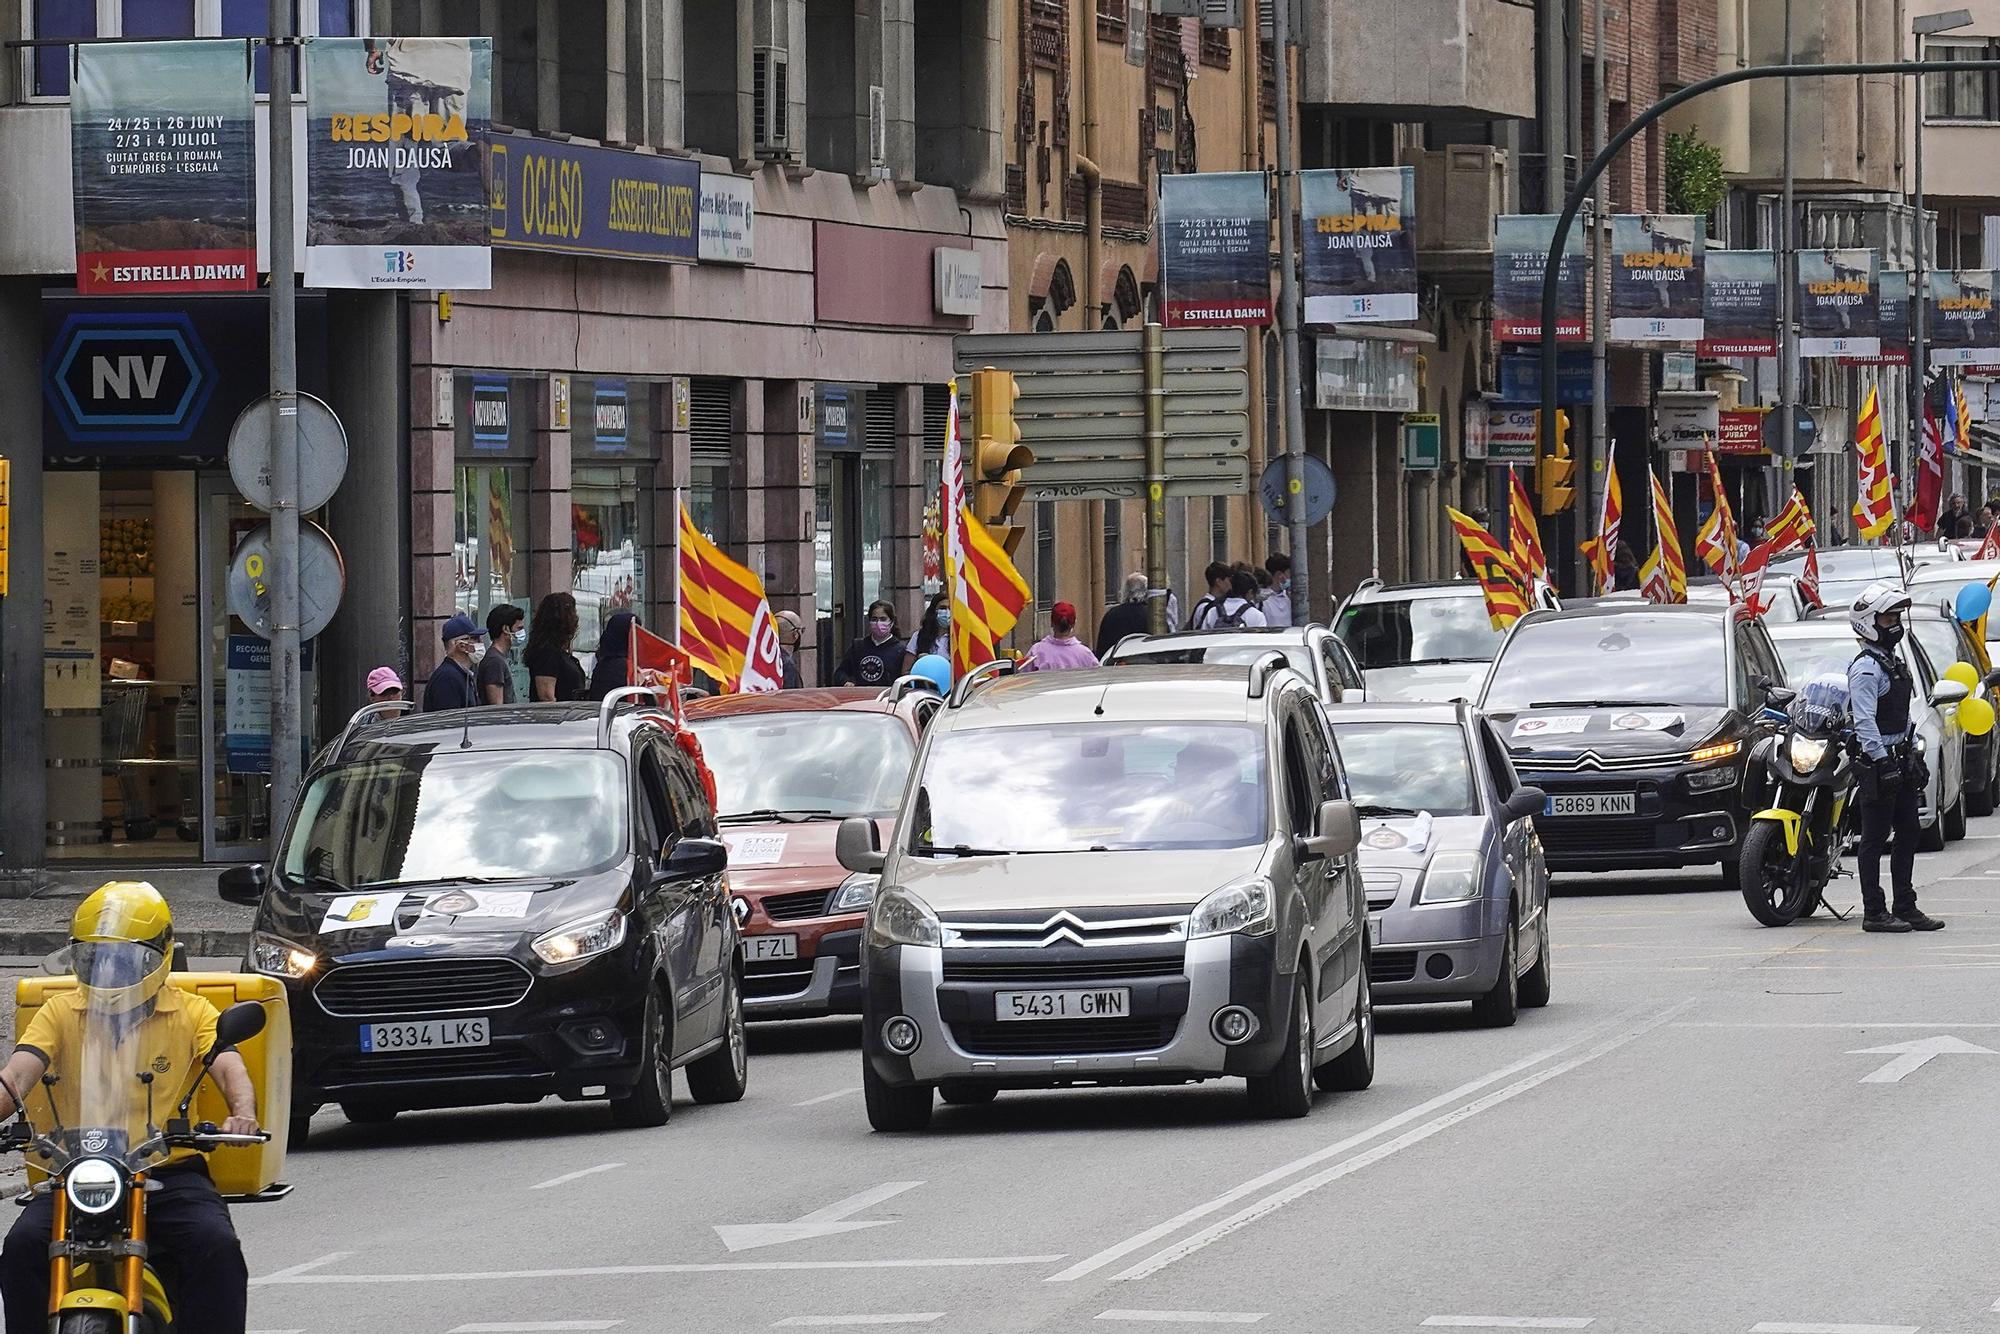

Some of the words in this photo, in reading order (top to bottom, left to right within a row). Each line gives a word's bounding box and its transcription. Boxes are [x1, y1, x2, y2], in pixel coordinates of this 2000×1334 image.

[107, 117, 150, 131] 24/25
[167, 116, 184, 129] 26
[190, 115, 223, 129] JUNY
[331, 113, 469, 143] RESPIRA
[116, 134, 140, 148] 2/3
[158, 133, 165, 147] 4
[171, 132, 218, 147] JULIOL
[106, 152, 139, 163] CIUTAT
[142, 151, 173, 162] GREGA
[184, 150, 223, 161] ROMANA
[346, 147, 389, 169] JOAN
[395, 143, 453, 169] DAUSÀ
[110, 162, 167, 175] D'EMPÚRIES
[176, 162, 219, 173] L'ESCALA
[522, 154, 583, 239] OCASO
[608, 178, 693, 238] ASSEGURANCES
[1231, 218, 1251, 226] JUNY
[1327, 235, 1354, 249] JOAN
[1356, 232, 1393, 249] DAUSÀ
[113, 265, 193, 284] ESTRELLA
[194, 264, 246, 281] DAMM
[1631, 269, 1653, 280] JOAN
[1655, 267, 1685, 281] DAUSÀ
[1816, 295, 1836, 306] JOAN
[1837, 294, 1863, 306] DAUSÀ
[1184, 309, 1233, 320] ESTRELLA
[1234, 308, 1266, 318] DAMM
[1945, 311, 1961, 320] JOAN
[1512, 326, 1542, 335] ESTREL
[1712, 345, 1747, 353] ESTRELLA
[1748, 345, 1771, 353] DAMM
[92, 355, 167, 399] NV
[474, 400, 507, 426] NOVAVENDA
[1555, 797, 1595, 813] 5869
[1600, 796, 1630, 812] KNN
[757, 938, 795, 958] FZL
[1012, 994, 1065, 1016] 5431
[1080, 992, 1121, 1014] GWN
[377, 1024, 433, 1048] 3334
[441, 1022, 484, 1045] LKS
